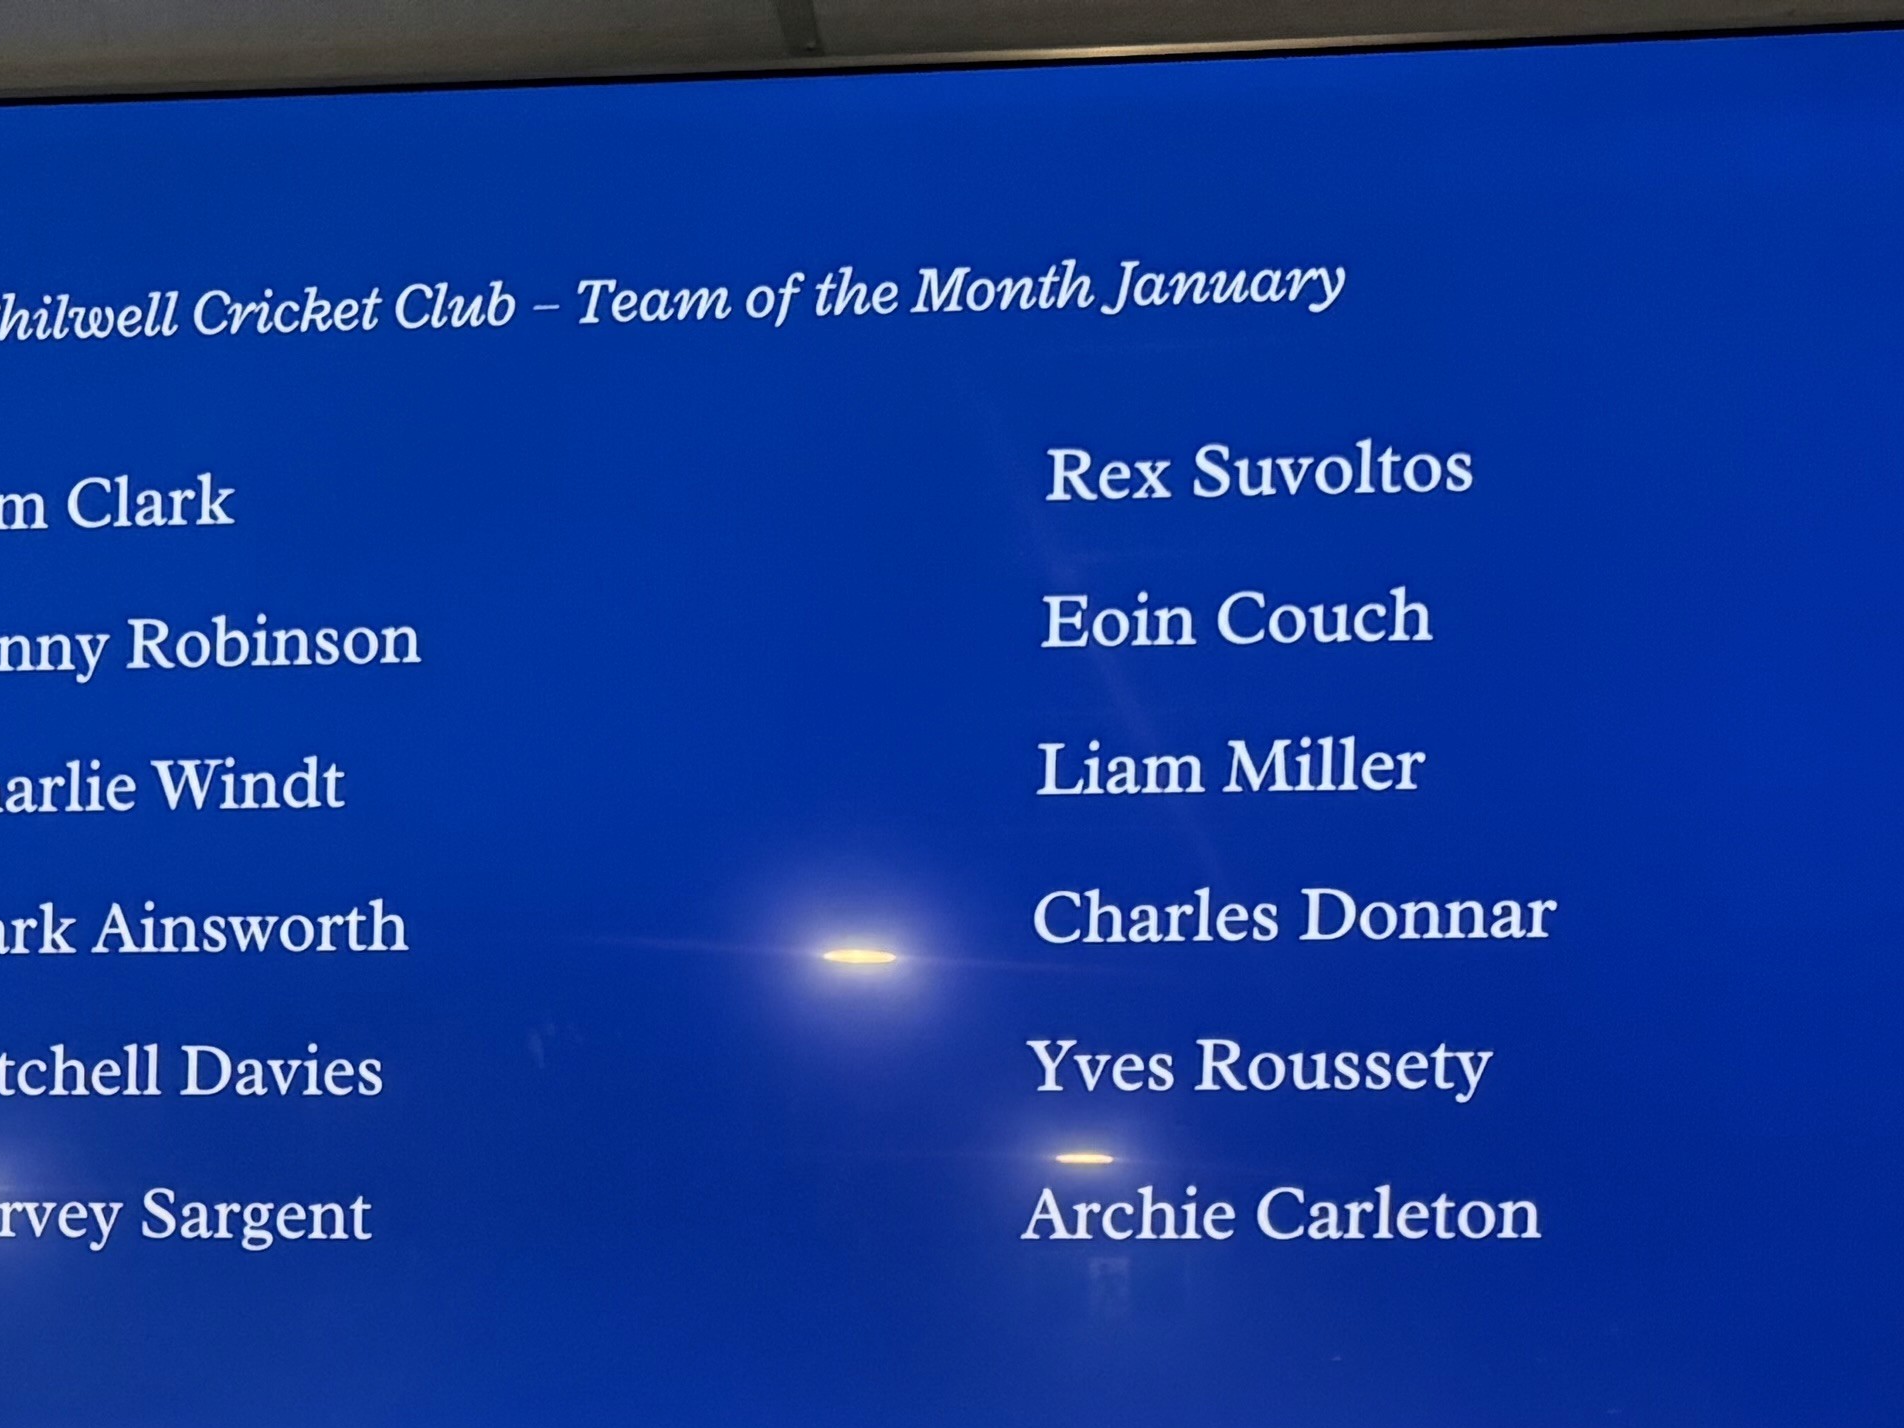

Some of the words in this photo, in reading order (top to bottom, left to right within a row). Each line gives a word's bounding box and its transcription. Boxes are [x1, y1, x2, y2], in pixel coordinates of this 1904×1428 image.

[194, 286, 383, 336] Cricket
[395, 281, 516, 329] Club
[577, 279, 732, 324] Team
[745, 271, 806, 328] of
[815, 265, 899, 317] the
[911, 259, 1095, 313] Month
[1100, 260, 1346, 315] January
[1046, 448, 1171, 501] Rex
[1193, 438, 1473, 498] Suvoltos
[67, 473, 236, 529] Clark
[127, 613, 421, 668] Robinson
[1042, 591, 1196, 648] Eoin
[1217, 586, 1433, 644] Couch
[151, 756, 346, 811] Windt
[1036, 739, 1206, 795] Liam
[1222, 735, 1426, 792] Miller
[91, 898, 410, 953] Ainsworth
[1033, 886, 1279, 944] Charles
[1299, 887, 1558, 941] Donnar
[180, 1043, 383, 1097] Davies
[1025, 1038, 1175, 1092] Yves
[1194, 1038, 1493, 1104] Roussety
[142, 1187, 373, 1251] Sargent
[1020, 1185, 1236, 1241] Archie
[1256, 1184, 1542, 1240] Carleton
